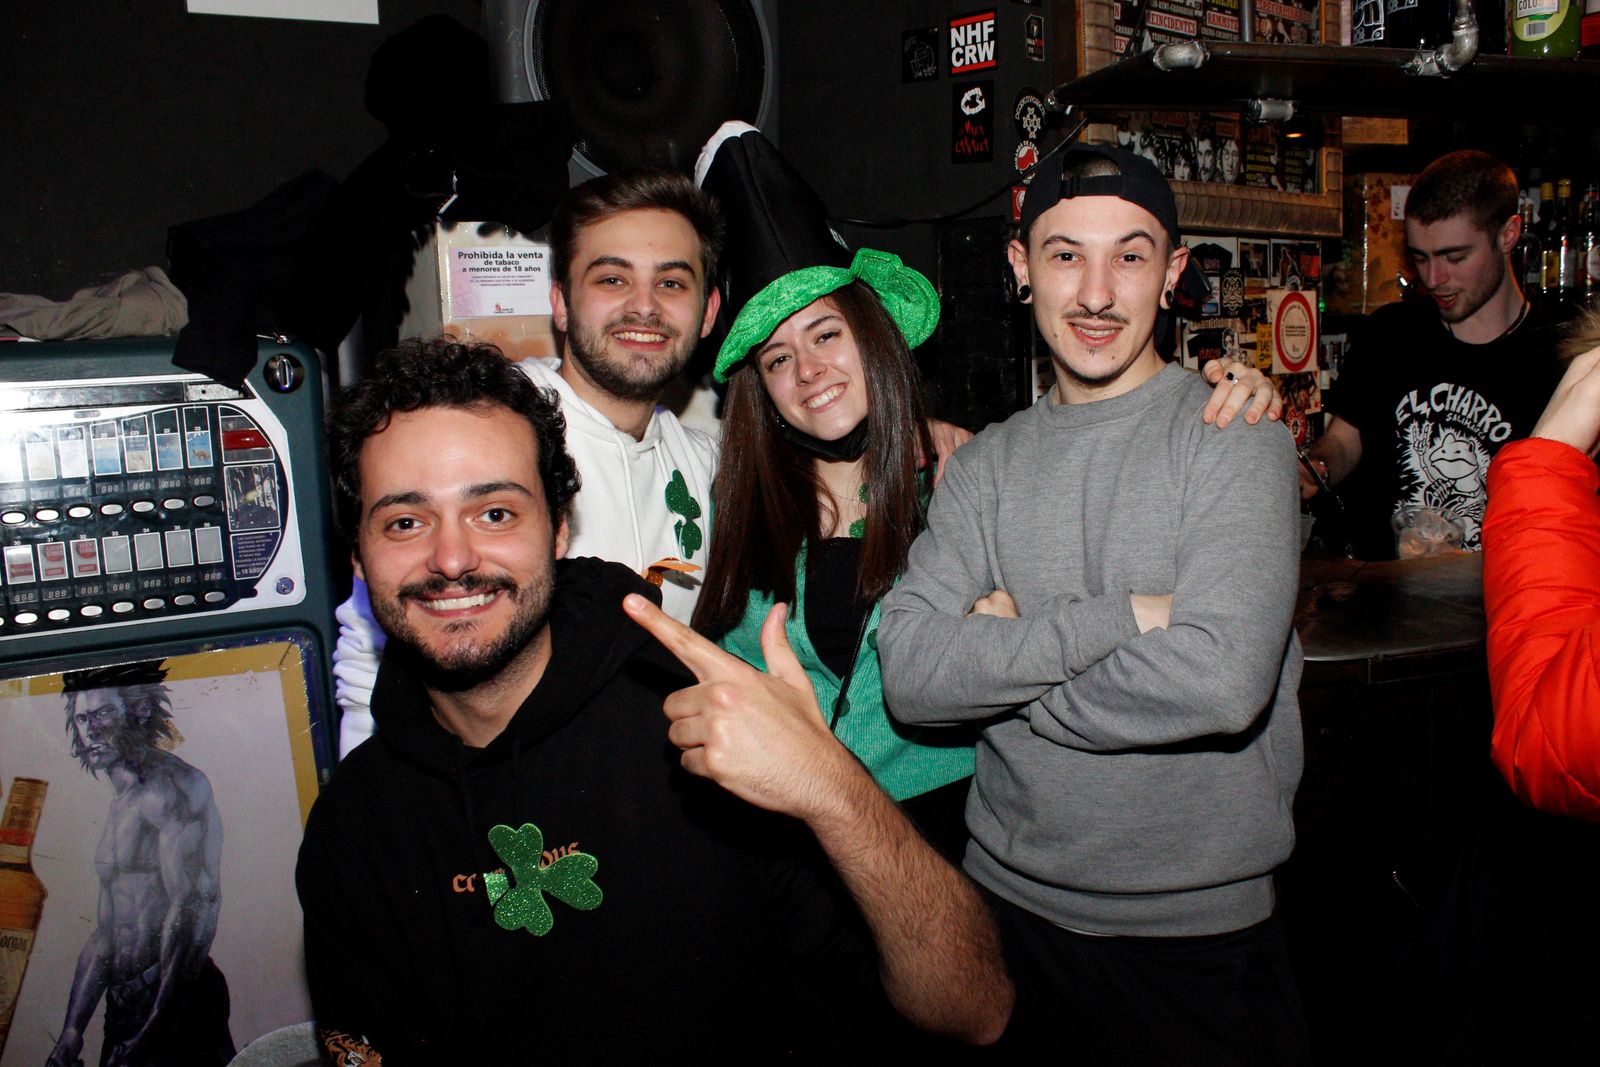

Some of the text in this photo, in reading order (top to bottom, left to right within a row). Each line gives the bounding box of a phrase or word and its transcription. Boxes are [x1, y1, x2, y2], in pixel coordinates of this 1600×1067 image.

[950, 20, 995, 48] NHF
[1147, 11, 1196, 34] REINCIDENTES
[951, 41, 995, 68] CRW
[458, 251, 543, 260] Prohibida la venta
[1395, 382, 1512, 443] EL CHARRO
[0, 932, 27, 952] organ
